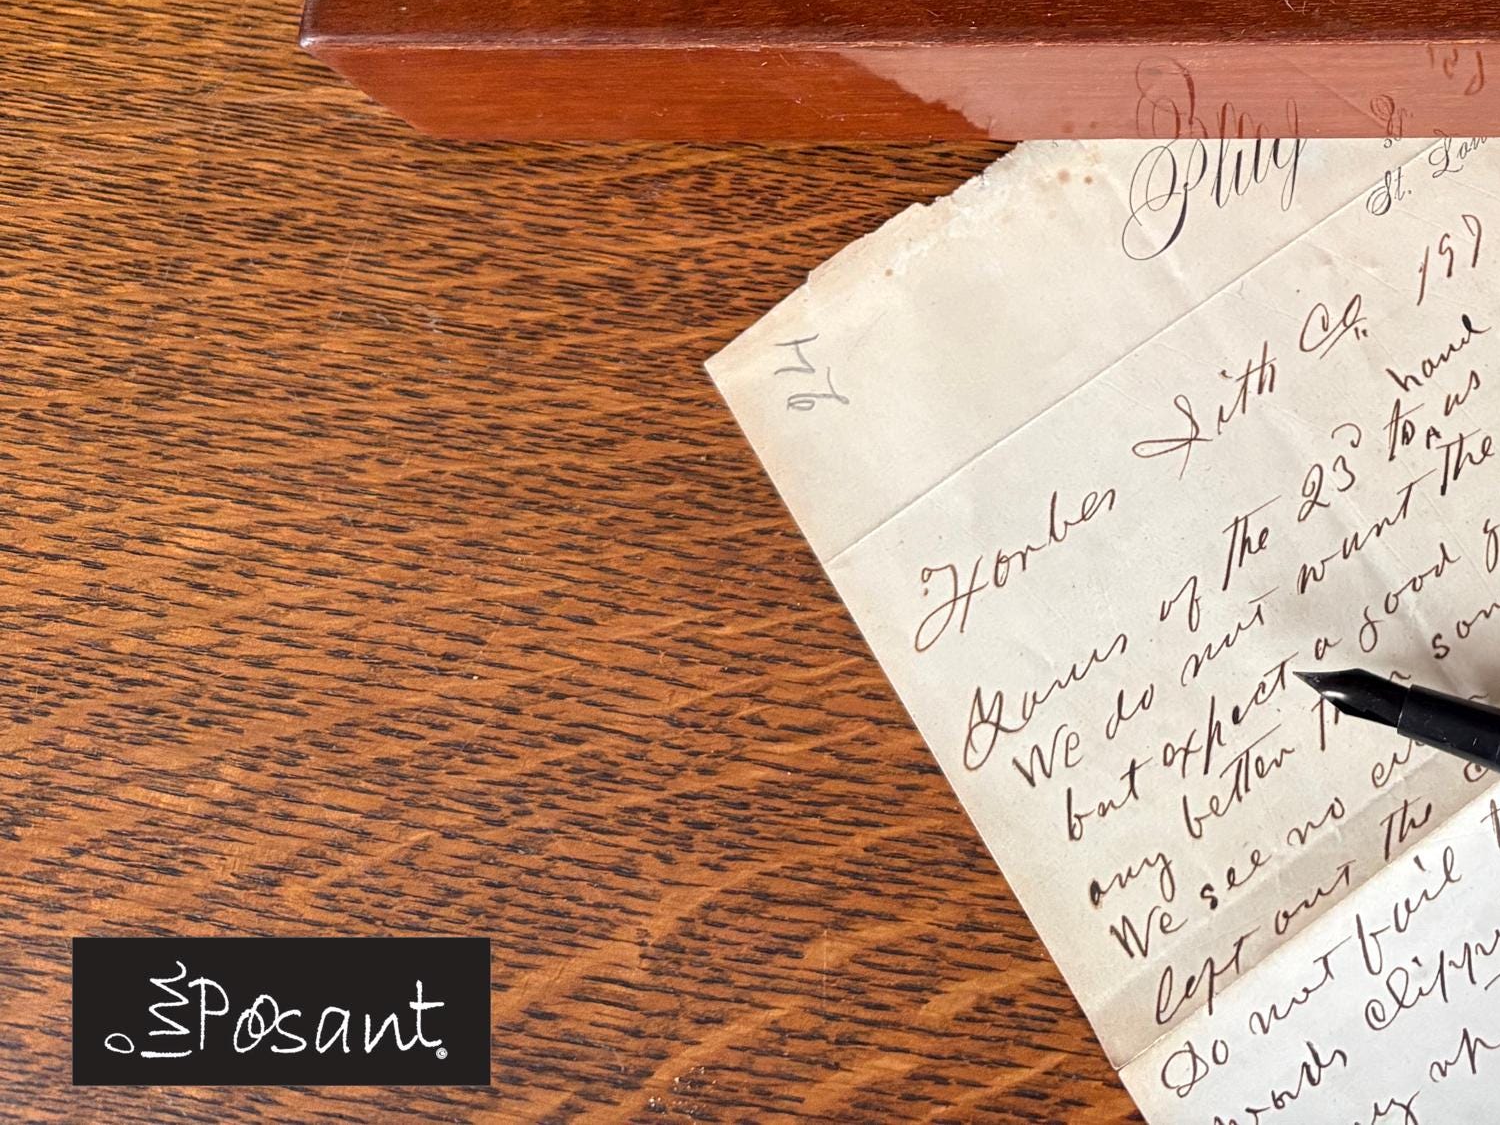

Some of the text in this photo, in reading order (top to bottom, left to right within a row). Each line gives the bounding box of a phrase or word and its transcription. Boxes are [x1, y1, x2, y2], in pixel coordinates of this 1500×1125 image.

[1365, 138, 1488, 217] St. Lou
[1384, 313, 1492, 393] hand
[1011, 723, 1084, 789] We
[1105, 682, 1155, 741] do
[1180, 586, 1279, 688] not
[1296, 468, 1437, 596] want
[1159, 574, 1202, 633] of
[1066, 756, 1154, 842] but
[1162, 651, 1299, 780] expect
[1314, 637, 1343, 662] a
[1358, 541, 1462, 654] good
[1088, 851, 1176, 942] any
[1182, 723, 1296, 841] better
[1108, 883, 1189, 960] We
[1199, 848, 1272, 911] see
[1286, 796, 1346, 847] no
[1155, 927, 1274, 1026] left
[1274, 859, 1356, 936] out
[1160, 1038, 1229, 1099] Do
[1248, 935, 1352, 1036] not
[1355, 845, 1463, 976] fail
